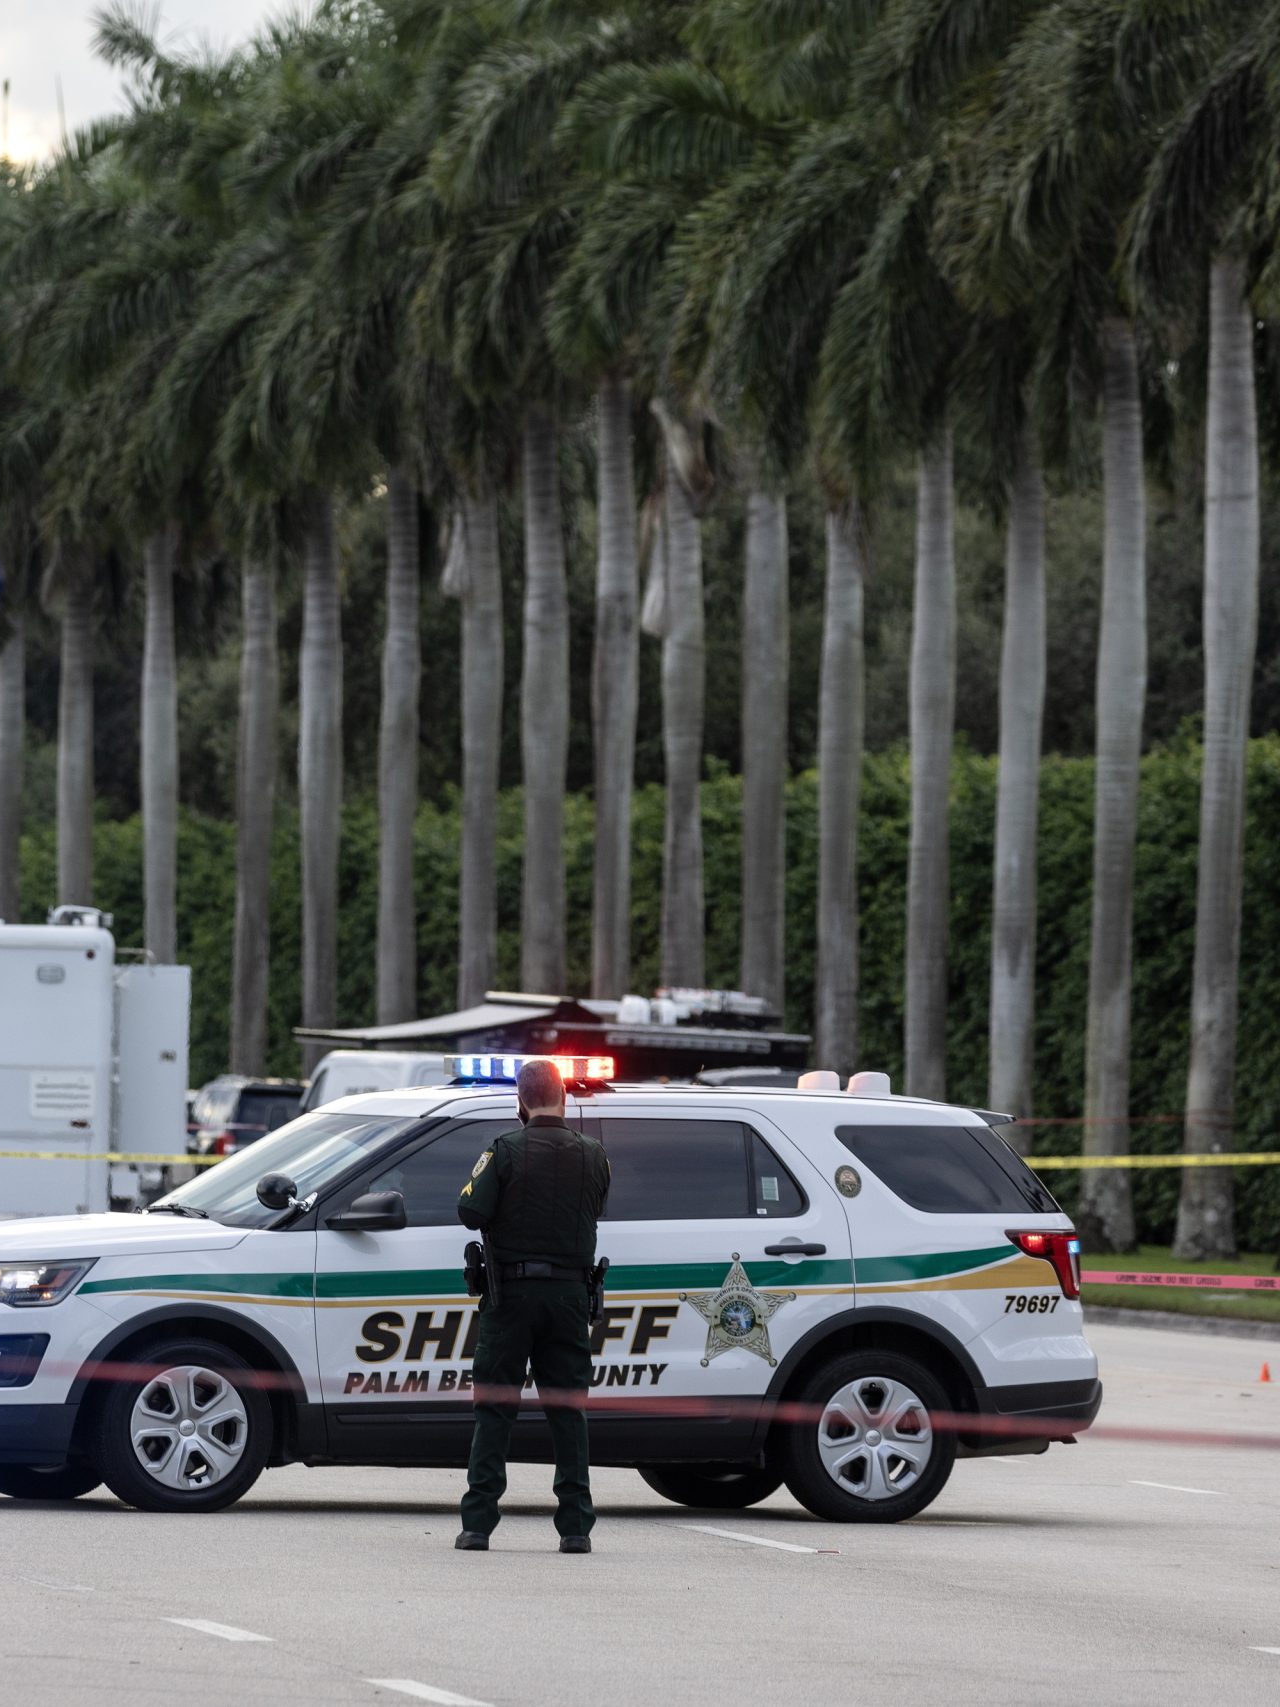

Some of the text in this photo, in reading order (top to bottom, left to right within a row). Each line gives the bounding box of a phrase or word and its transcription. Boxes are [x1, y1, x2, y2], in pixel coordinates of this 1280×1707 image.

[1004, 1295, 1061, 1314] 79697
[355, 1305, 680, 1364] SHIFF
[343, 1370, 430, 1394] PALM
[587, 1363, 669, 1388] UNTY
